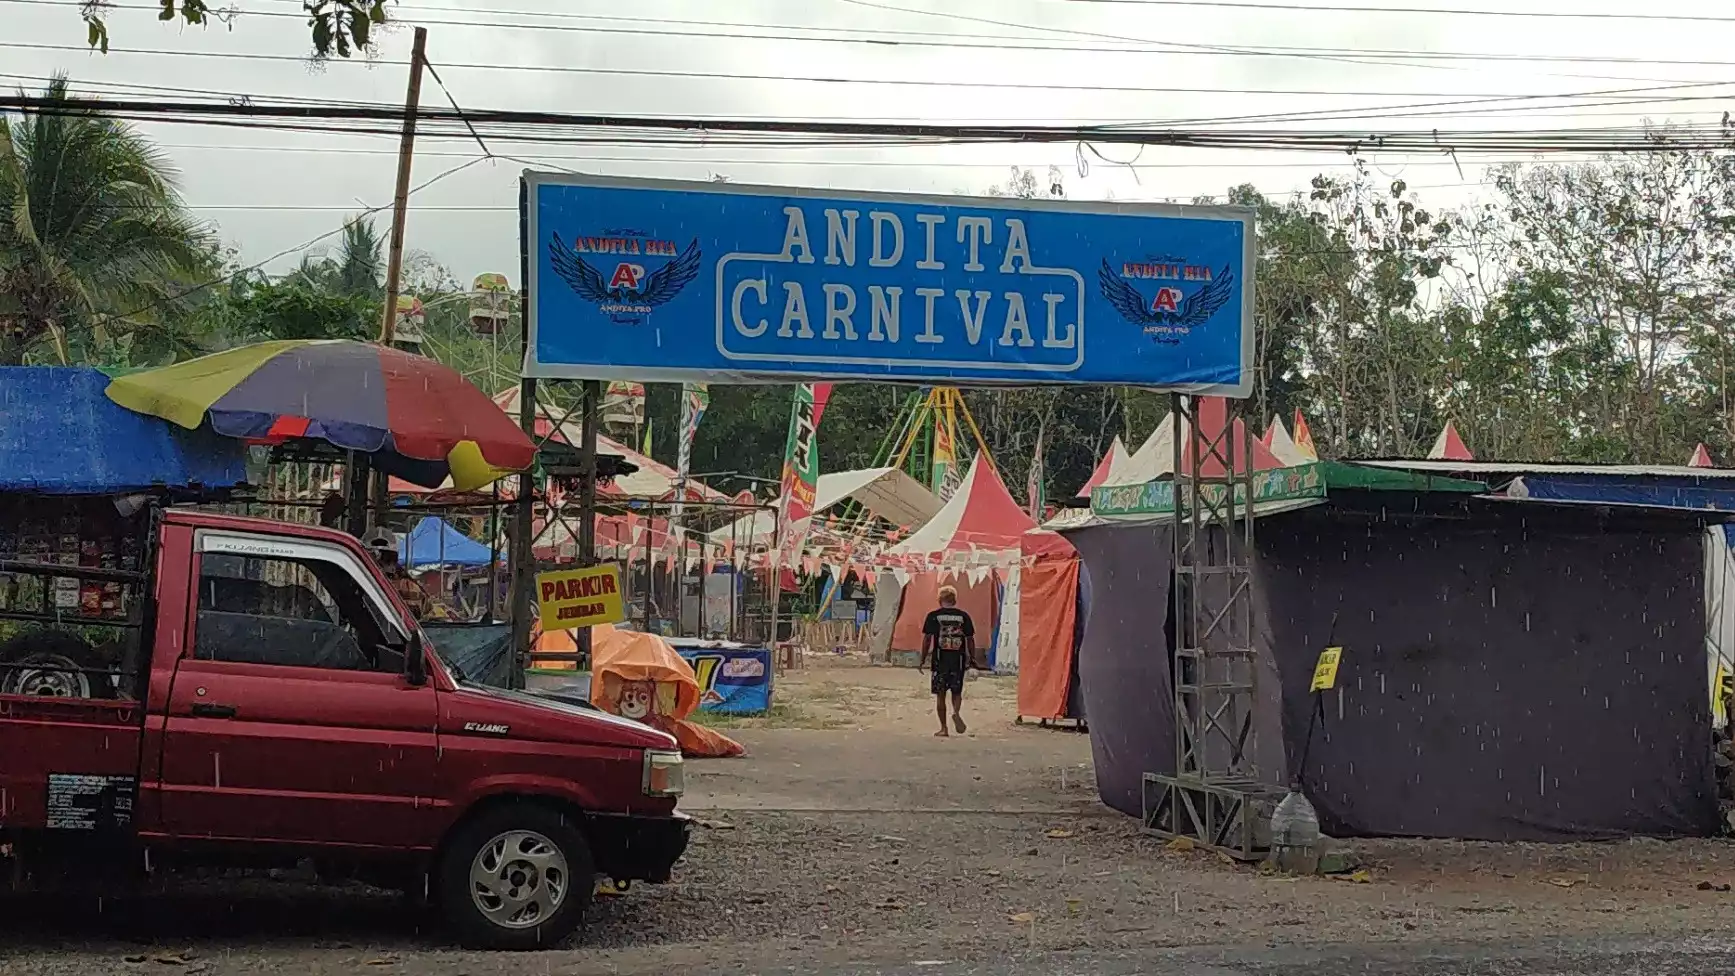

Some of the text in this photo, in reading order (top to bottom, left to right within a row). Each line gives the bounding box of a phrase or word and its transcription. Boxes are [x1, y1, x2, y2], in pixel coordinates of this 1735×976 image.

[574, 236, 640, 255] ANDITA
[780, 206, 1034, 274] ANDITA
[731, 279, 1076, 349] CARNIVAL
[541, 574, 617, 603] PARKIR
